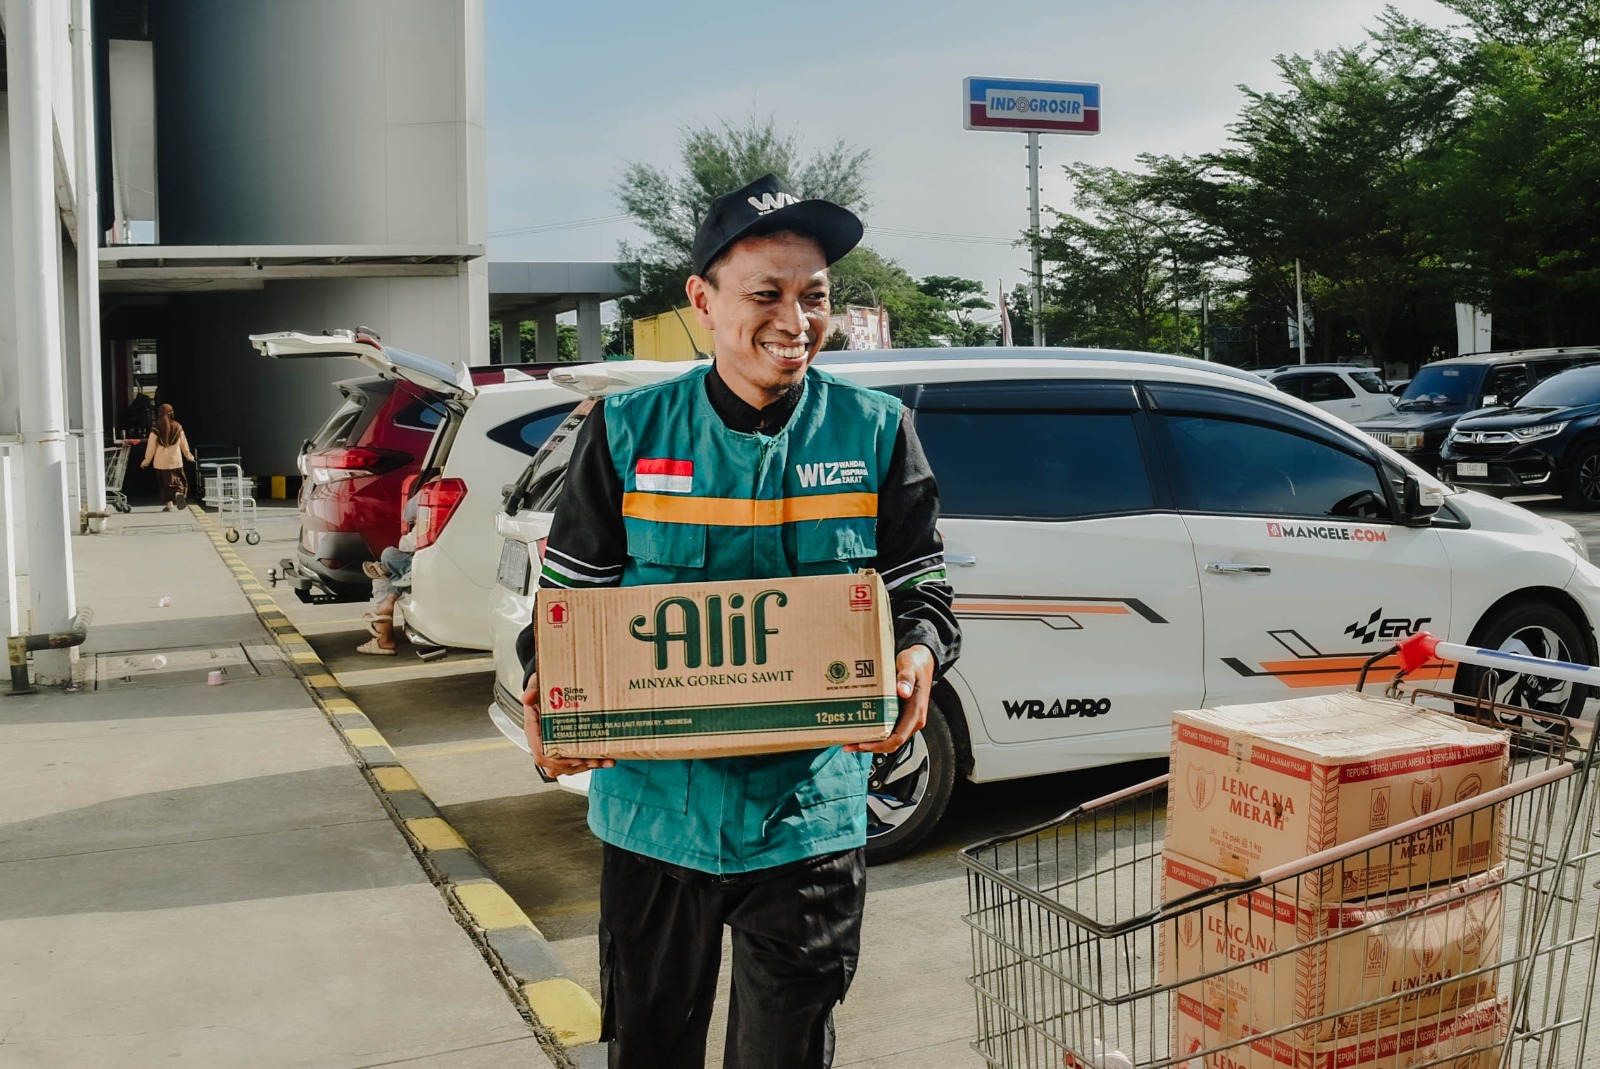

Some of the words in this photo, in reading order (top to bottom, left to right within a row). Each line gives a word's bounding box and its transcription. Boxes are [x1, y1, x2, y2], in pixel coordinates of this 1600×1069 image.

[989, 96, 1081, 115] INDOGROSIR
[747, 191, 801, 211] WI
[796, 462, 841, 488] WIZ
[841, 476, 863, 484] ZAKAT
[1281, 525, 1387, 542] MANGELE.COM
[855, 586, 867, 599] 5
[629, 589, 788, 670] Alif
[855, 660, 875, 678] SNI
[628, 676, 685, 690] MINYAK
[687, 673, 748, 687] GORENG
[751, 670, 794, 683] SAWIT
[564, 694, 588, 702] Darby
[862, 701, 871, 709] ISI
[816, 712, 845, 724] 12pcs
[847, 713, 854, 721] x
[856, 710, 877, 720] 1Ltr
[1002, 698, 1111, 720] WRAPRO
[1182, 728, 1198, 741] TEPUNG
[1198, 733, 1213, 745] TERIGU
[1270, 755, 1291, 769] JAJANAN
[1290, 761, 1307, 773] PASAR
[1346, 766, 1369, 778] TEPUNG
[1370, 762, 1389, 775] TERIGU
[1390, 760, 1407, 771] UNTUK
[1408, 756, 1425, 768] ANEKA
[1426, 751, 1456, 764] GORENGAN
[1221, 775, 1295, 815] LENCANA
[1229, 798, 1285, 831] MERAH
[1400, 839, 1444, 860] MERAH
[1171, 865, 1186, 878] TEPUNG
[1337, 1051, 1358, 1063] EPUNG
